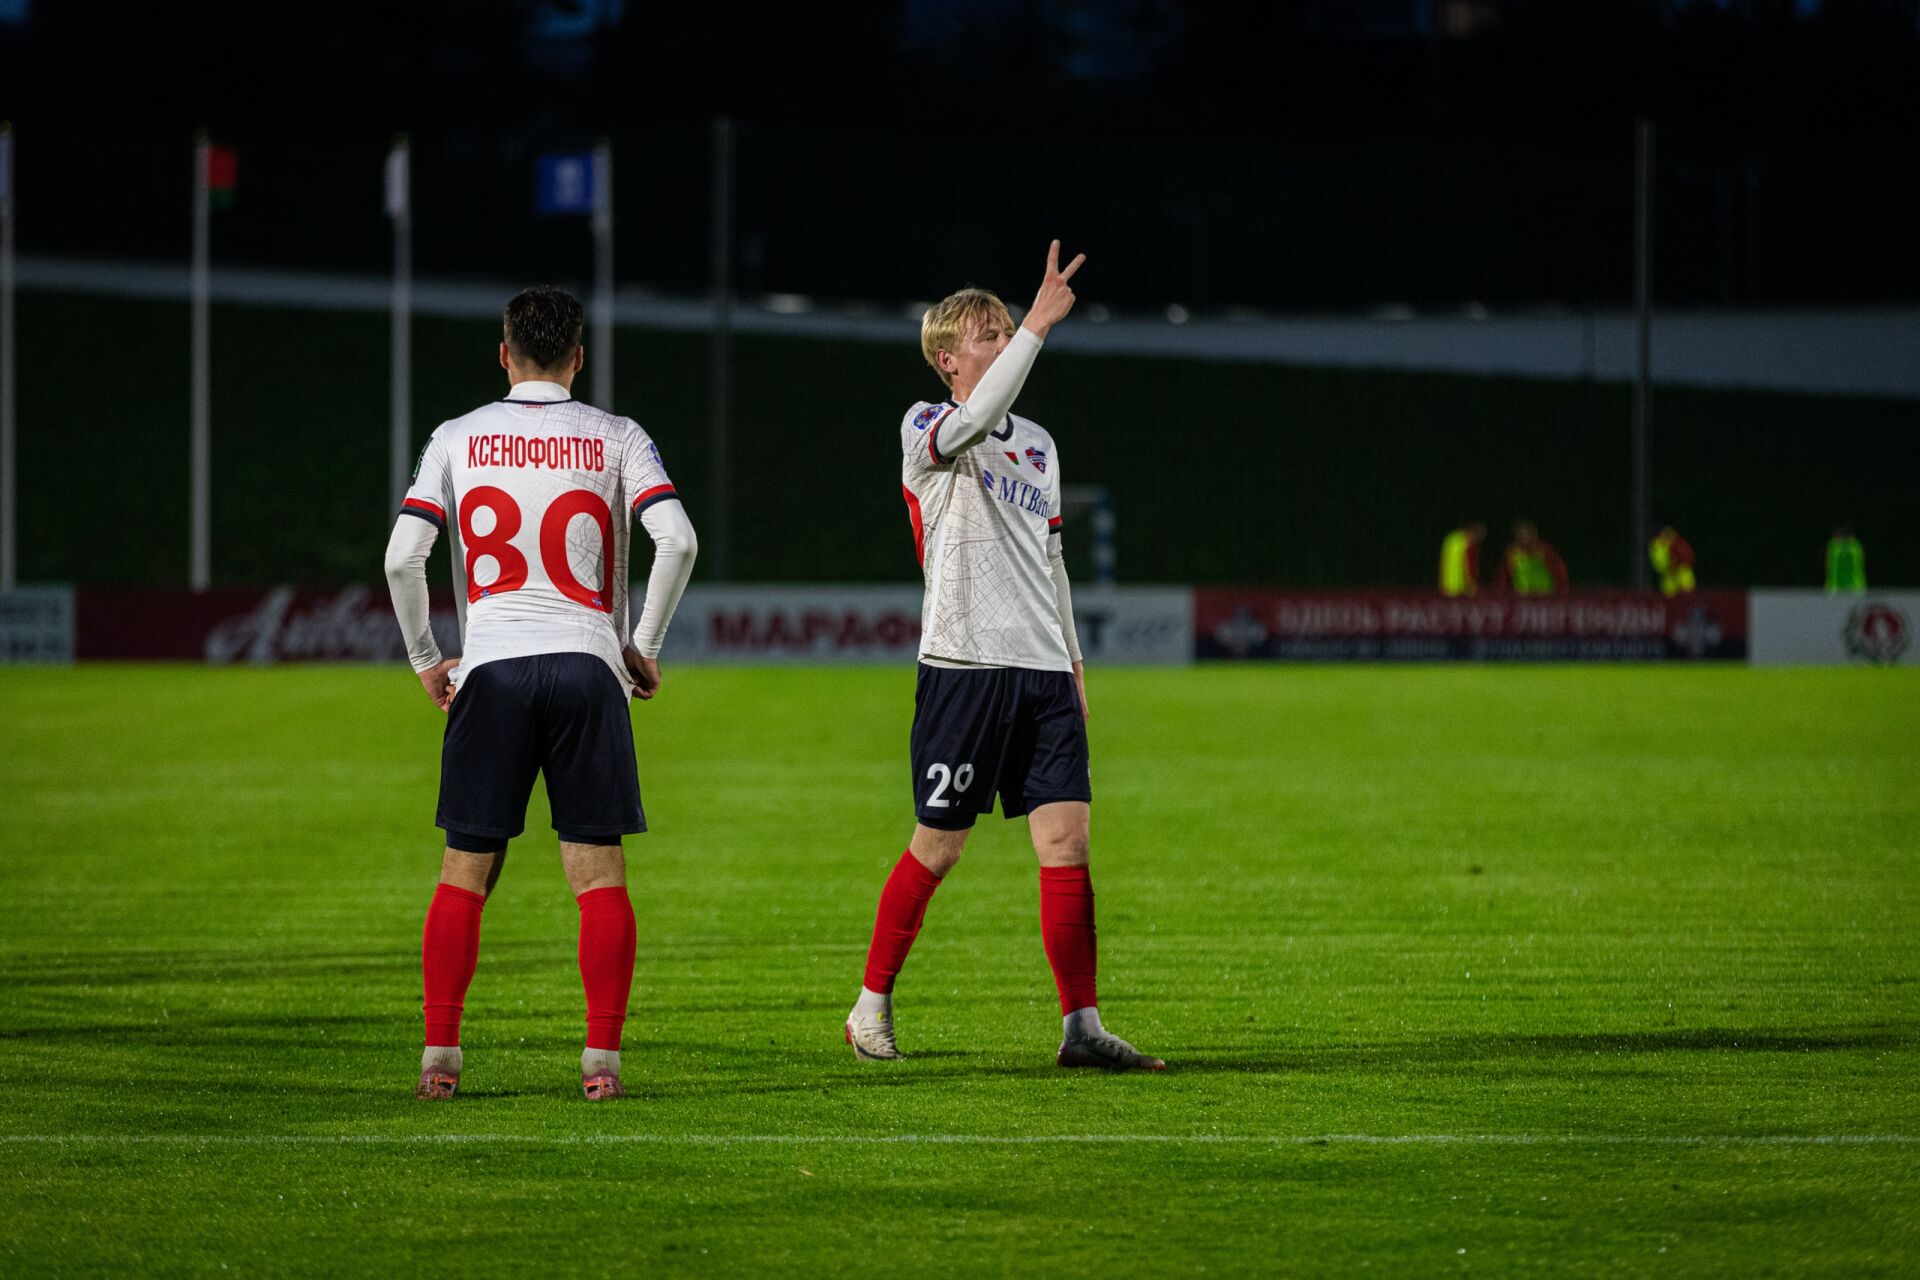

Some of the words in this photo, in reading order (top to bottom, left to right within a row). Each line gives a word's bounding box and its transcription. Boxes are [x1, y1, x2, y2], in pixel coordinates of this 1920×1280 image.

[468, 434, 604, 472] КСЕНОФОНТОВ
[998, 476, 1050, 518] MTBan
[459, 485, 615, 614] 80
